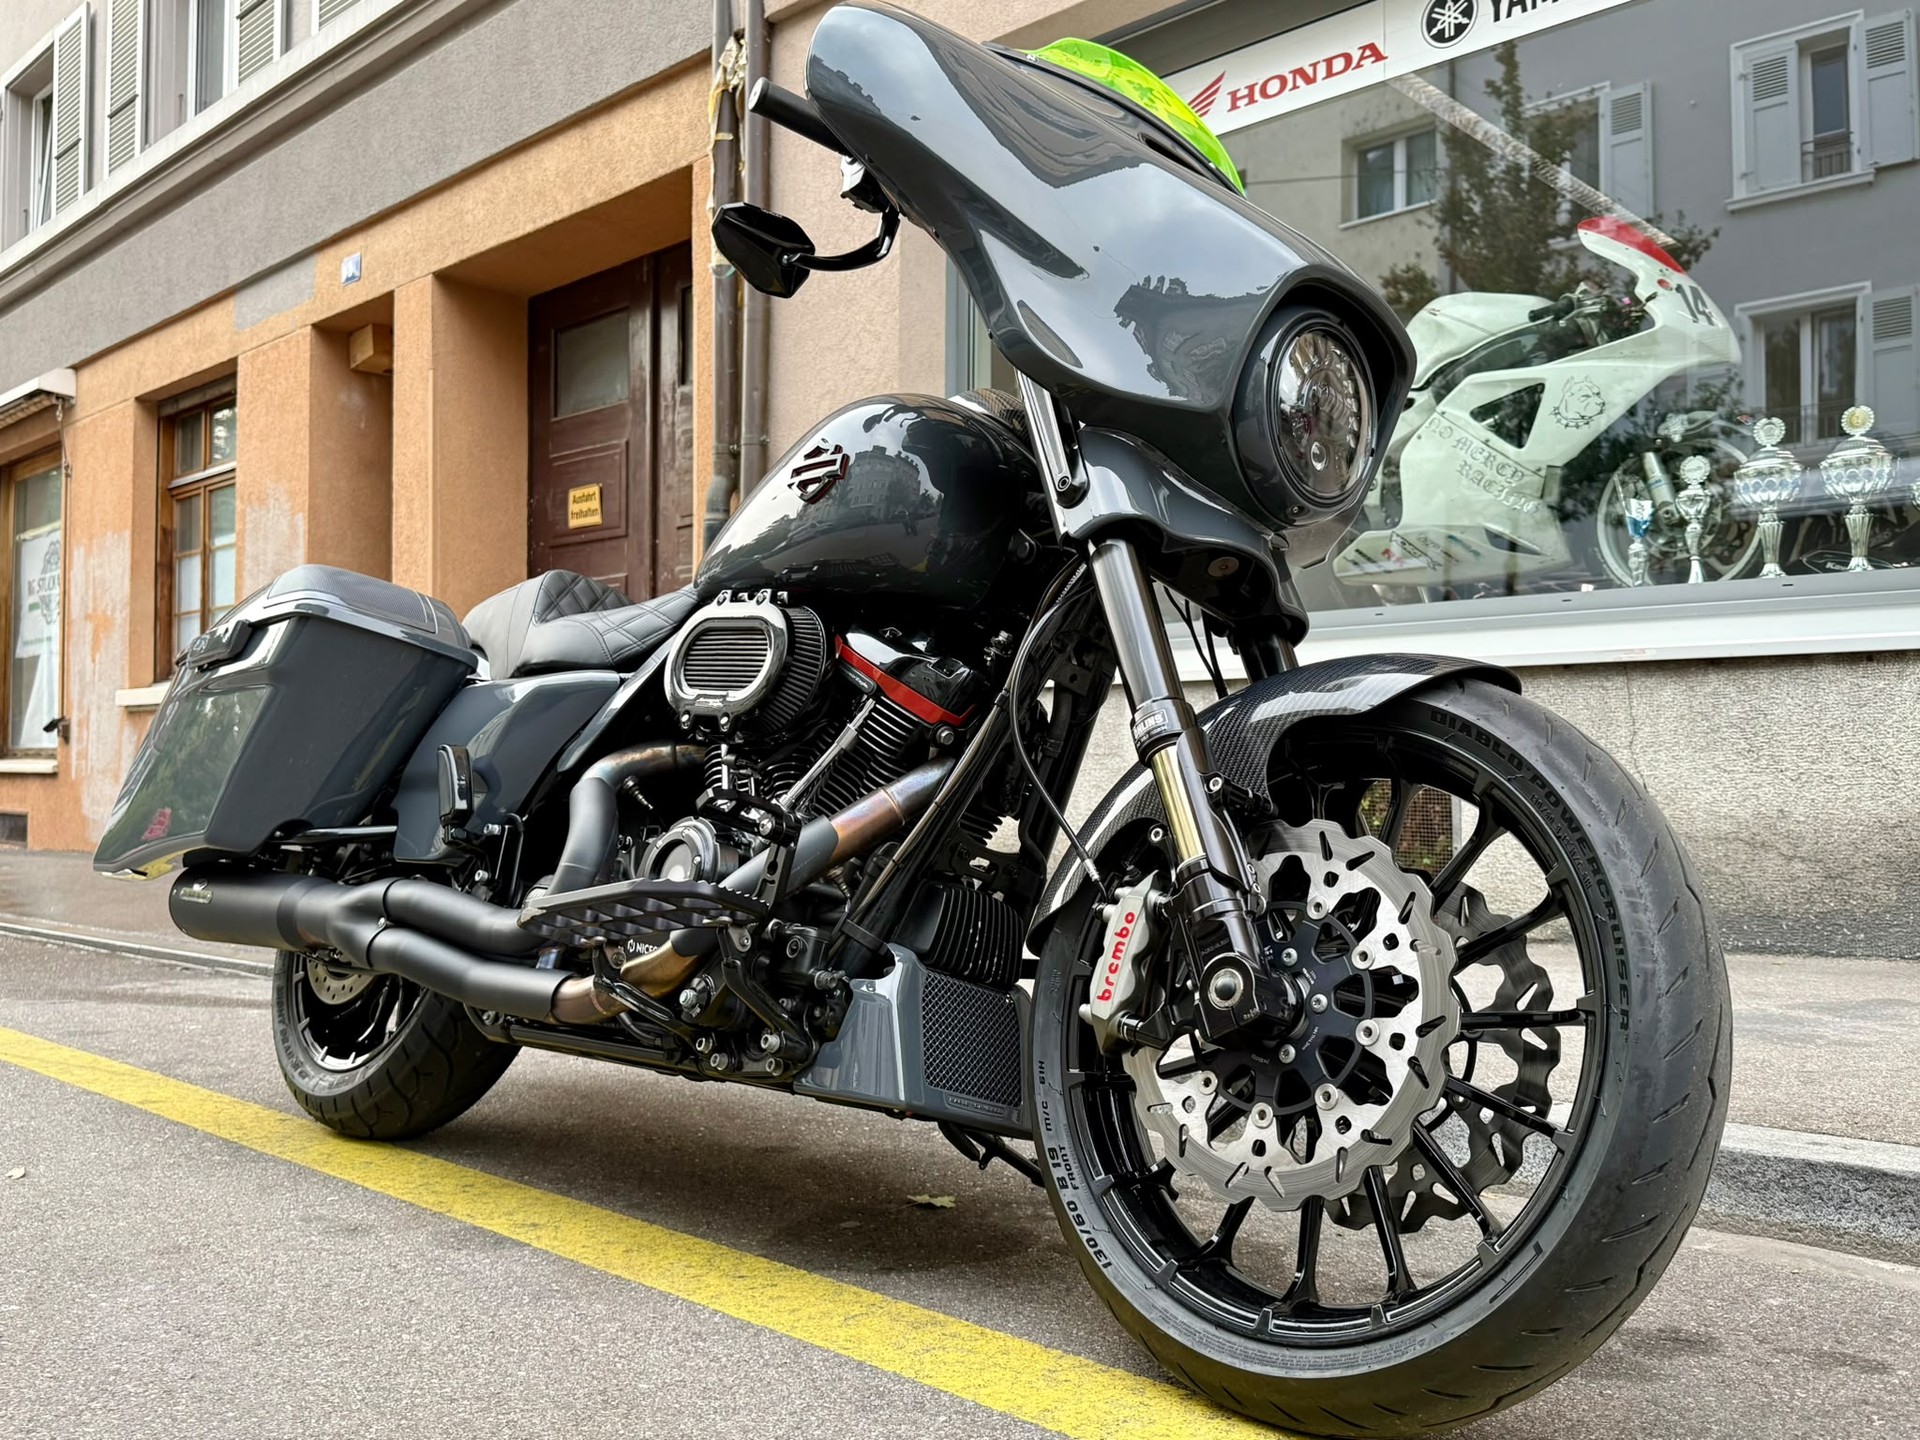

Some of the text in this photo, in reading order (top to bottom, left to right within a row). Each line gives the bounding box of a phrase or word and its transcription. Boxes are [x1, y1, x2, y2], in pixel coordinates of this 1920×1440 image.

[1226, 42, 1388, 113] HONDA
[1675, 284, 1715, 326] 14
[570, 508, 599, 520] freihalten
[572, 491, 597, 504] Ausfahrt
[1431, 710, 1523, 772] DIABLO
[1096, 911, 1136, 1002] brembo
[1038, 1060, 1046, 1086] 61H
[1047, 1146, 1062, 1168] 19
[1058, 1144, 1080, 1191] FRONT
[1056, 1175, 1069, 1191] B
[1066, 1200, 1112, 1270] 130/60
